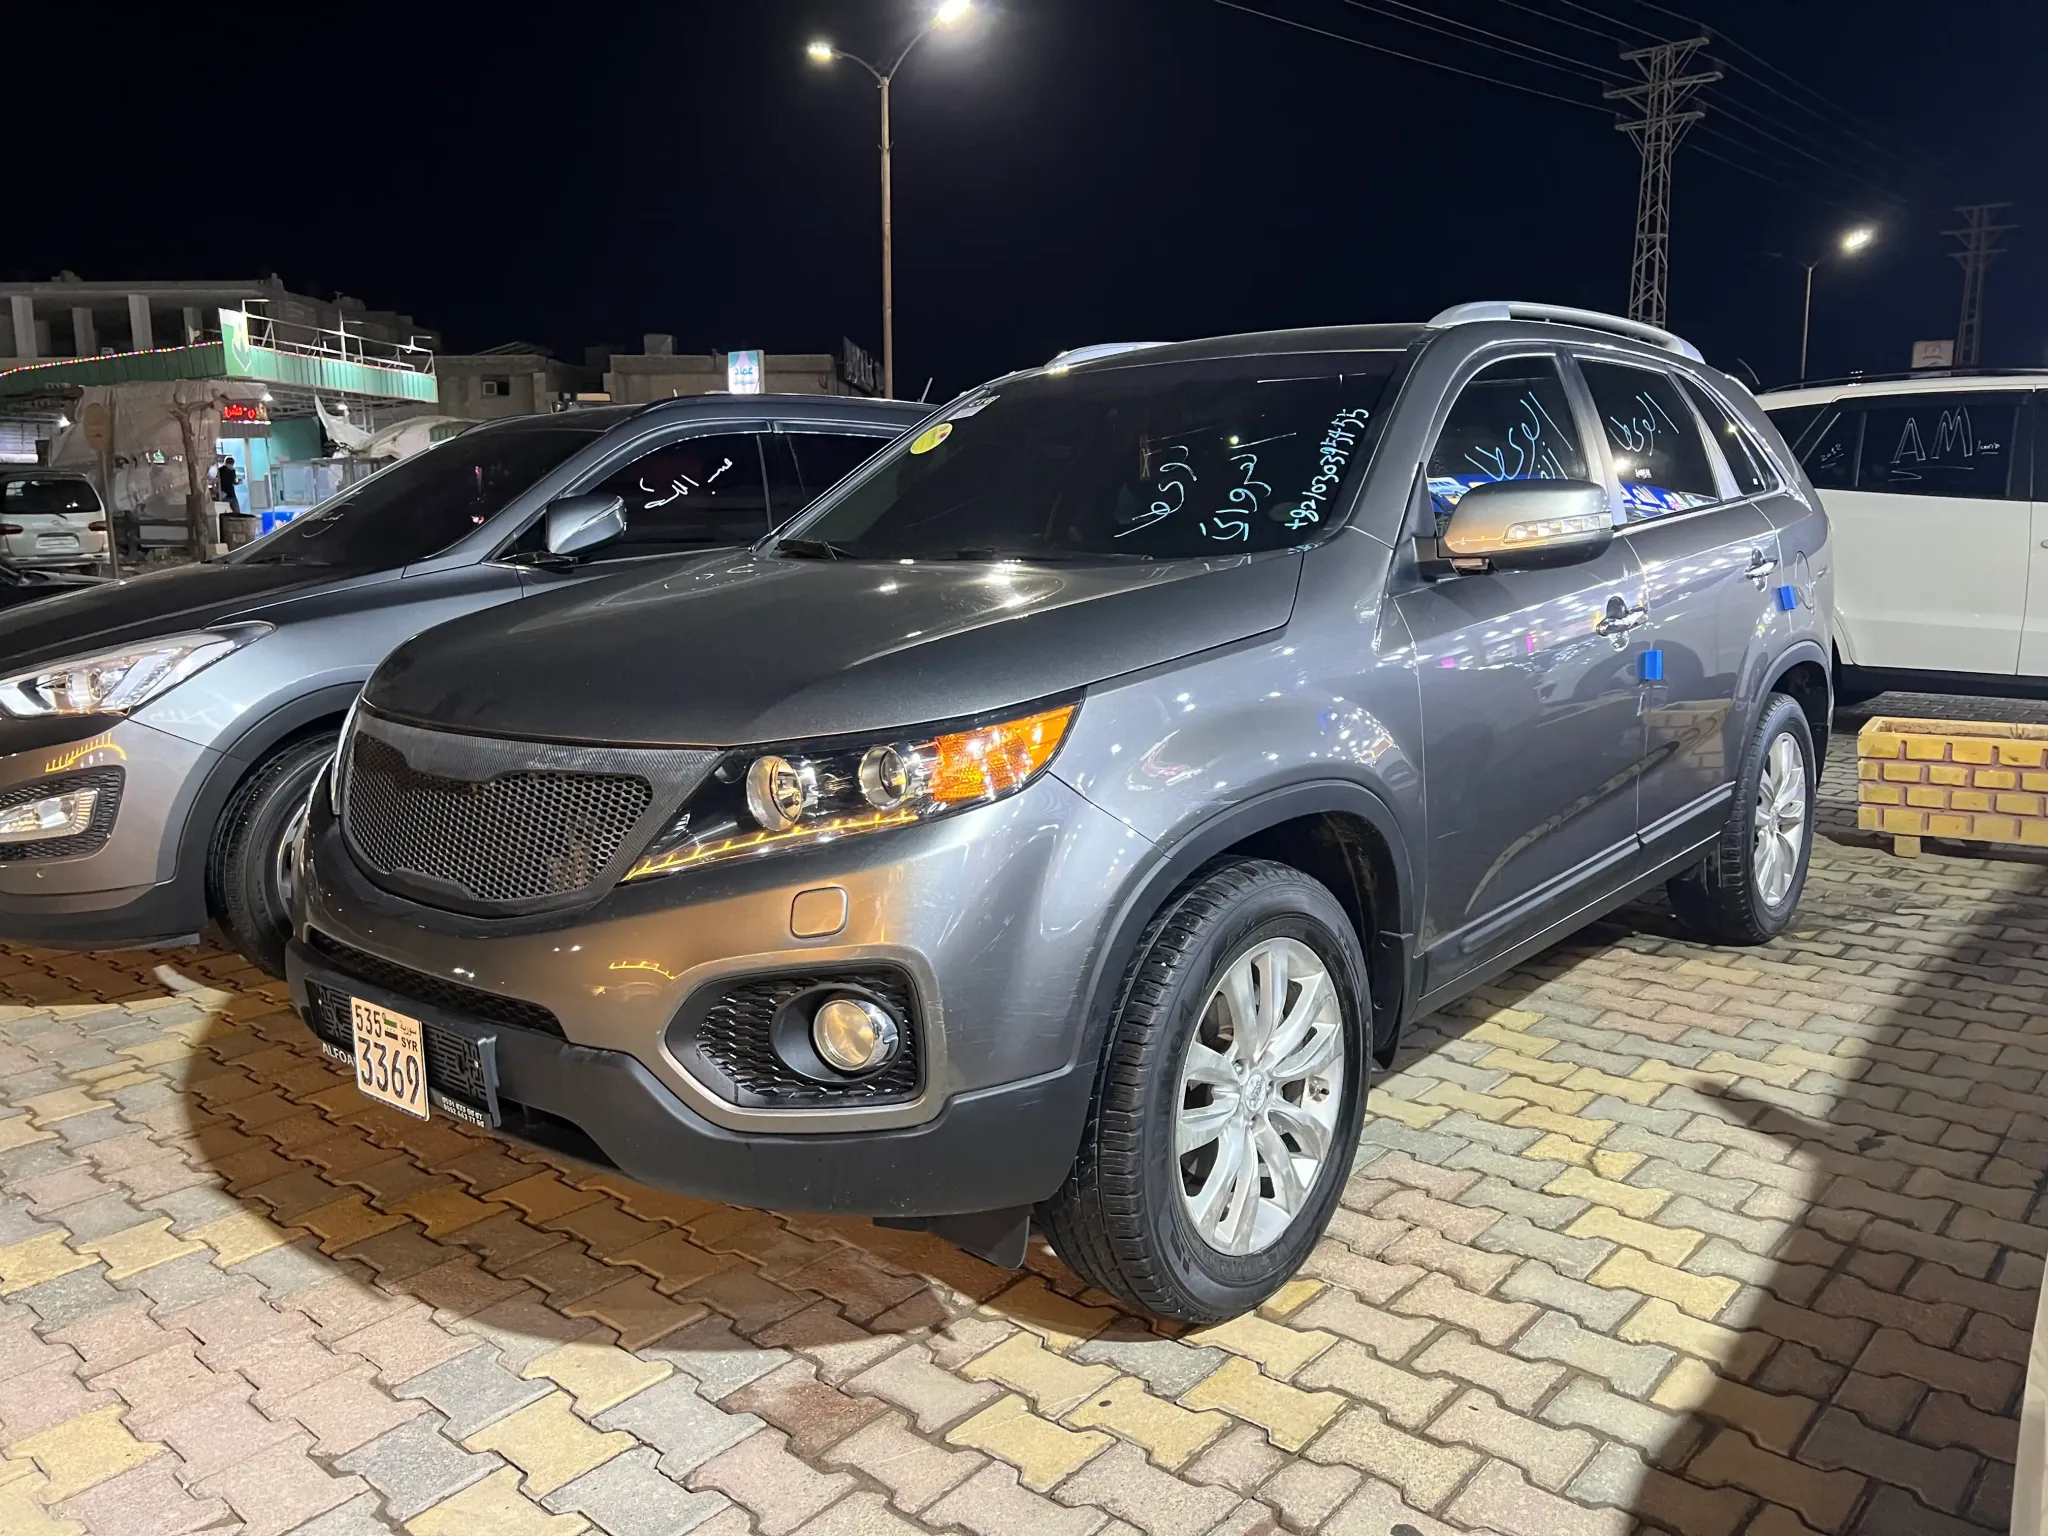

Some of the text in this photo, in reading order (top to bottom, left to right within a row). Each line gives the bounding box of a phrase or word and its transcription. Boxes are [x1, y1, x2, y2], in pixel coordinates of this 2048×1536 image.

[1890, 405, 1973, 464] AM
[354, 1004, 382, 1038] 535
[401, 1036, 418, 1052] SYR
[358, 1036, 420, 1105] 3369
